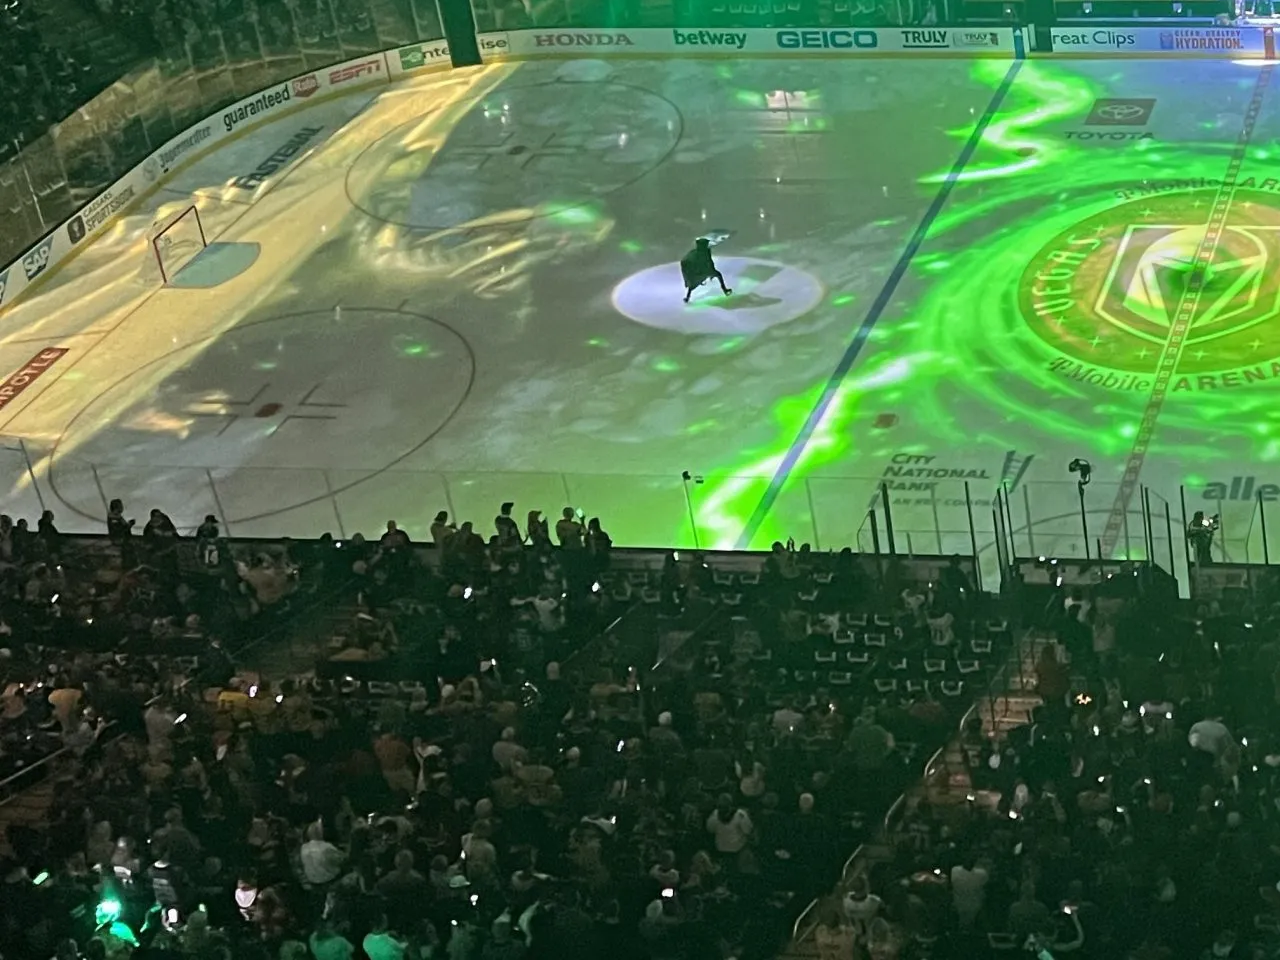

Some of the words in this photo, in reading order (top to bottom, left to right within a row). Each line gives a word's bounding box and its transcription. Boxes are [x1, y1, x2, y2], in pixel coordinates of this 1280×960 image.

[534, 33, 634, 46] HONDA
[673, 29, 748, 50] betway
[776, 30, 878, 49] GEICO
[901, 31, 948, 44] TRULY
[1052, 32, 1089, 45] reat
[1092, 30, 1135, 48] Clips
[329, 59, 381, 85] ESPN
[223, 83, 290, 132] guaranteed
[1063, 130, 1154, 140] TOYOTA
[23, 245, 50, 277] SAP
[1032, 234, 1101, 316] VEGAS
[0, 348, 62, 407] IPOTLE
[890, 453, 937, 465] CITY
[881, 465, 991, 480] NATIONAL
[876, 479, 939, 491] BANK
